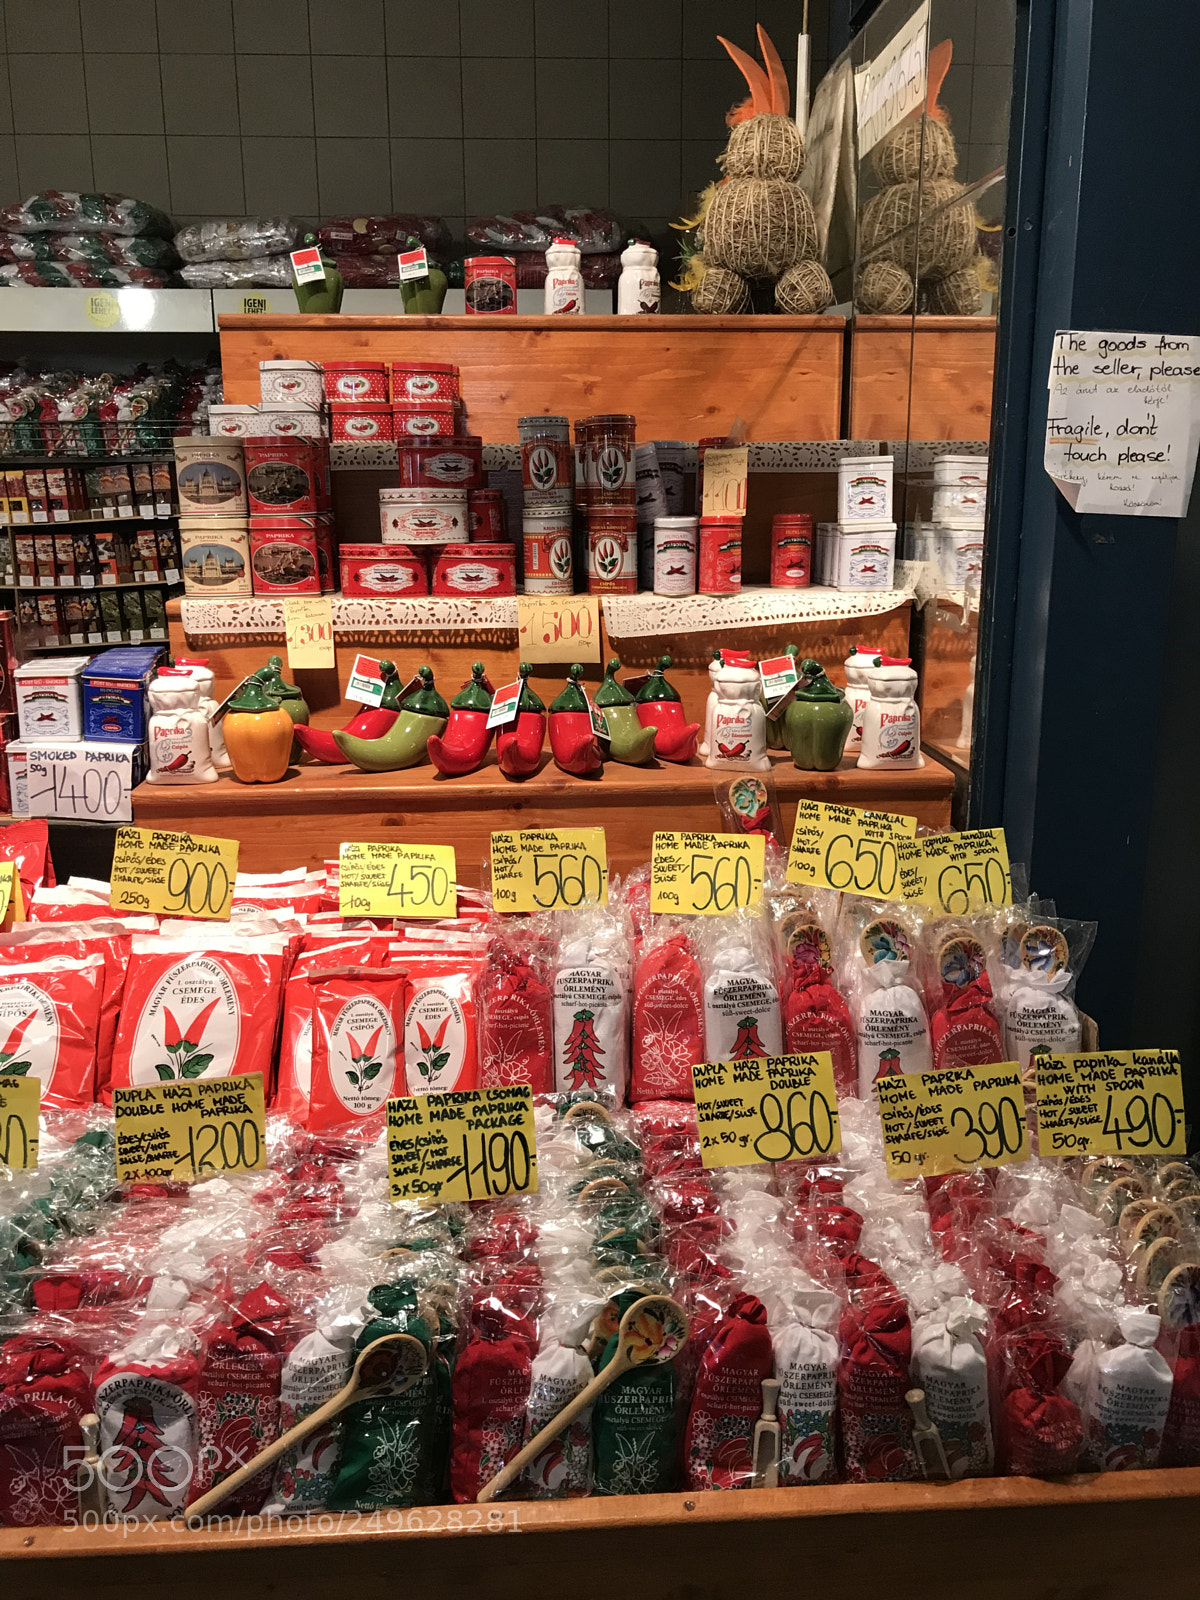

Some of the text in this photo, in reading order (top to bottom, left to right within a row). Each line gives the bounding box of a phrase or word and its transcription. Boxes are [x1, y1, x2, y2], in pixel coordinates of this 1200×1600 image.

[1056, 331, 1189, 358] The goods from
[1053, 355, 1200, 381] the seller, please
[1048, 415, 1109, 443] Fragile,
[1064, 443, 1171, 466] touch please!
[717, 713, 745, 729] Paprika
[880, 713, 911, 728] Paprika
[154, 726, 185, 741] Paprika
[30, 751, 130, 763] SMOKED PAPRIKA
[30, 764, 47, 776] 50g
[799, 812, 821, 821] HOME
[828, 815, 852, 825] MADE
[152, 832, 193, 843] PAPRIKA
[520, 832, 558, 841] PAPRIKA
[681, 832, 717, 841] PAPRIKA
[117, 841, 220, 855] HOME MADE PAPRIKA
[367, 844, 402, 853] PAPRIKA
[492, 842, 586, 854] HOME MADE PAPRIKA
[656, 840, 750, 850] HOME MADE PAPRIKA
[898, 839, 992, 861] HOME MADE PAPRIKA
[372, 852, 393, 860] MADE
[397, 853, 436, 861] PAPRIKA
[119, 890, 149, 909] 250g
[172, 986, 217, 995] CSEMEGE
[723, 991, 767, 1002] ŐRLEMÉNY
[149, 986, 168, 1017] MAGYAR
[180, 995, 205, 1004] ÉDES
[347, 1017, 378, 1025] CSEMEGE
[865, 1024, 910, 1032] ŐRLEMÉNY
[693, 1063, 727, 1078] DUPLA
[767, 1055, 819, 1068] PAPRIKA
[695, 1067, 817, 1089] HOME MADE PAPRIKA
[770, 1077, 811, 1090] DOUBLE
[878, 1069, 974, 1092] HÁZI PAPRIKA
[1038, 1066, 1178, 1086] HOME MADE PAPRIKA
[115, 1089, 156, 1103] DUPLA
[198, 1078, 255, 1096] PAPRIKA
[880, 1074, 1021, 1104] HOME MADE PAPRIKA
[1063, 1080, 1144, 1095] WITH SPOON
[427, 1091, 481, 1107] PAPRIKA
[487, 1086, 530, 1100] CSOMAG
[115, 1094, 246, 1118] DOUBLE HOME MADE
[201, 1104, 253, 1118] PAPRIKA
[388, 1101, 529, 1127] HOME MADE PAPRIKA
[466, 1113, 525, 1130] PACKAGE
[789, 1362, 828, 1371] MAGYAR
[782, 1380, 833, 1390] ŐRLEMÉNY
